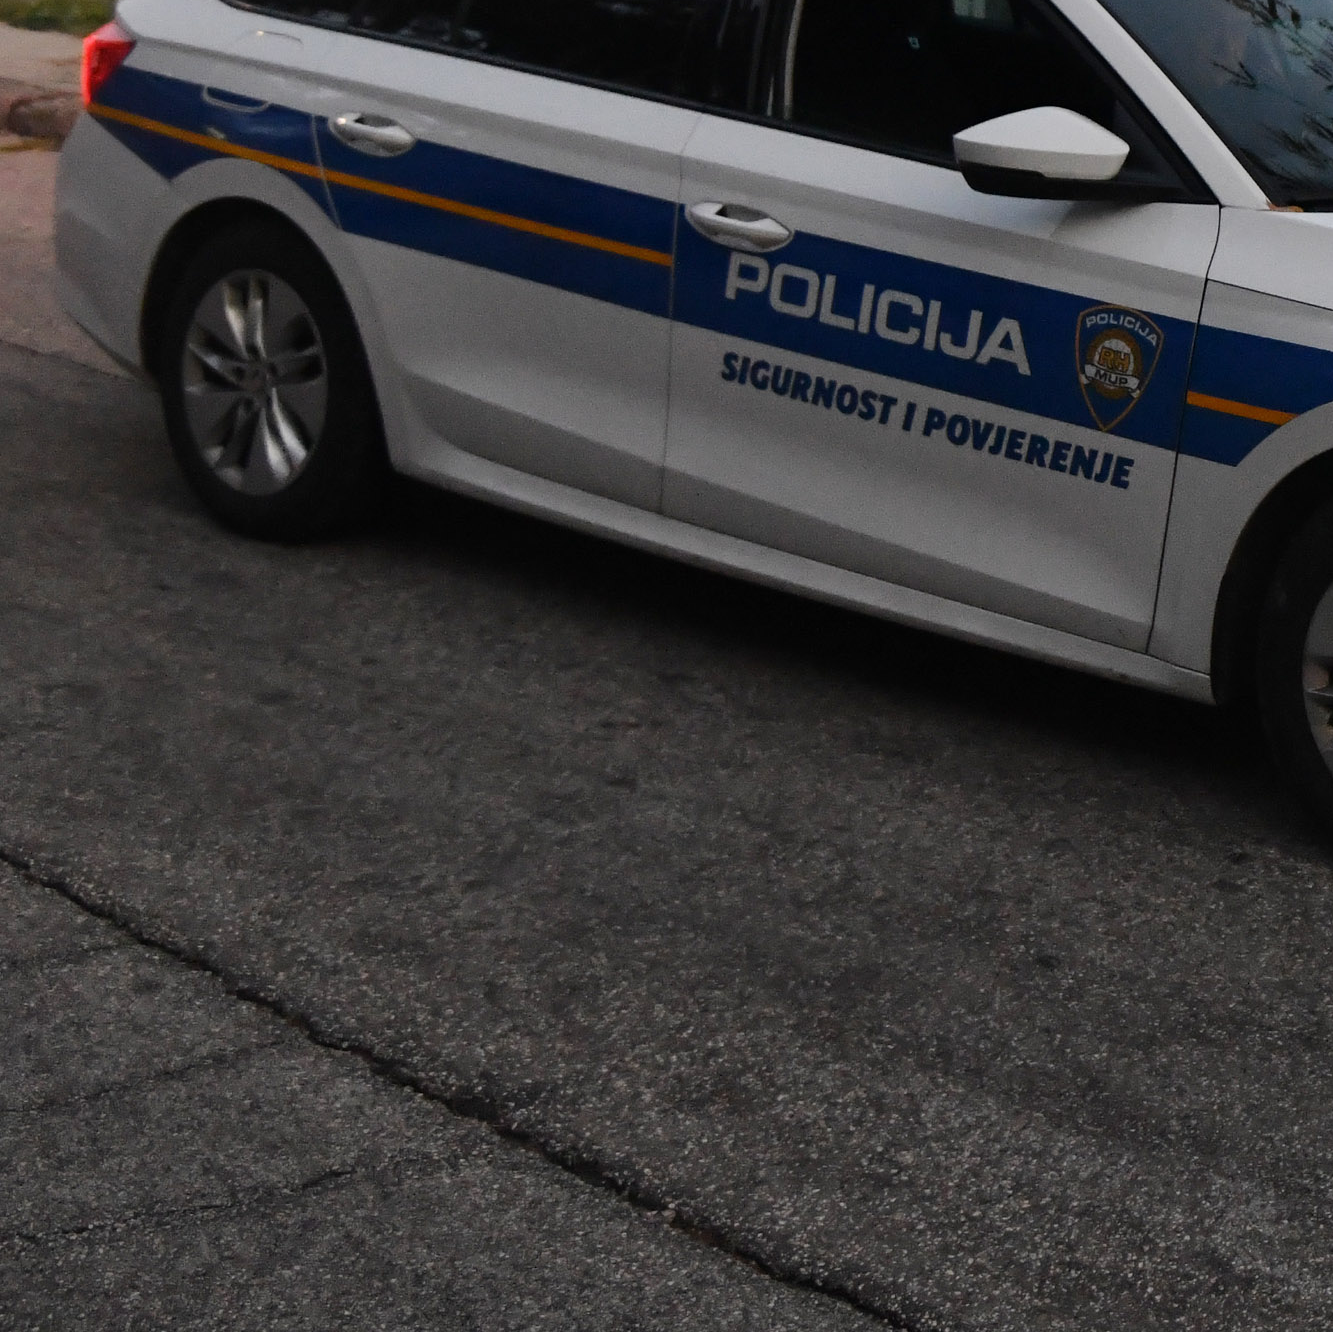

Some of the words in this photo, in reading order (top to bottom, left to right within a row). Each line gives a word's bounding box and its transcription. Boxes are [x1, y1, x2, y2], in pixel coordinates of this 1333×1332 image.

[724, 251, 1032, 377] POLICIJA
[1085, 312, 1158, 347] POLICIJA
[1094, 369, 1129, 386] MUP
[721, 351, 898, 426] SIGURNOST
[901, 401, 917, 432] I
[922, 406, 1136, 490] POVJERENJE
